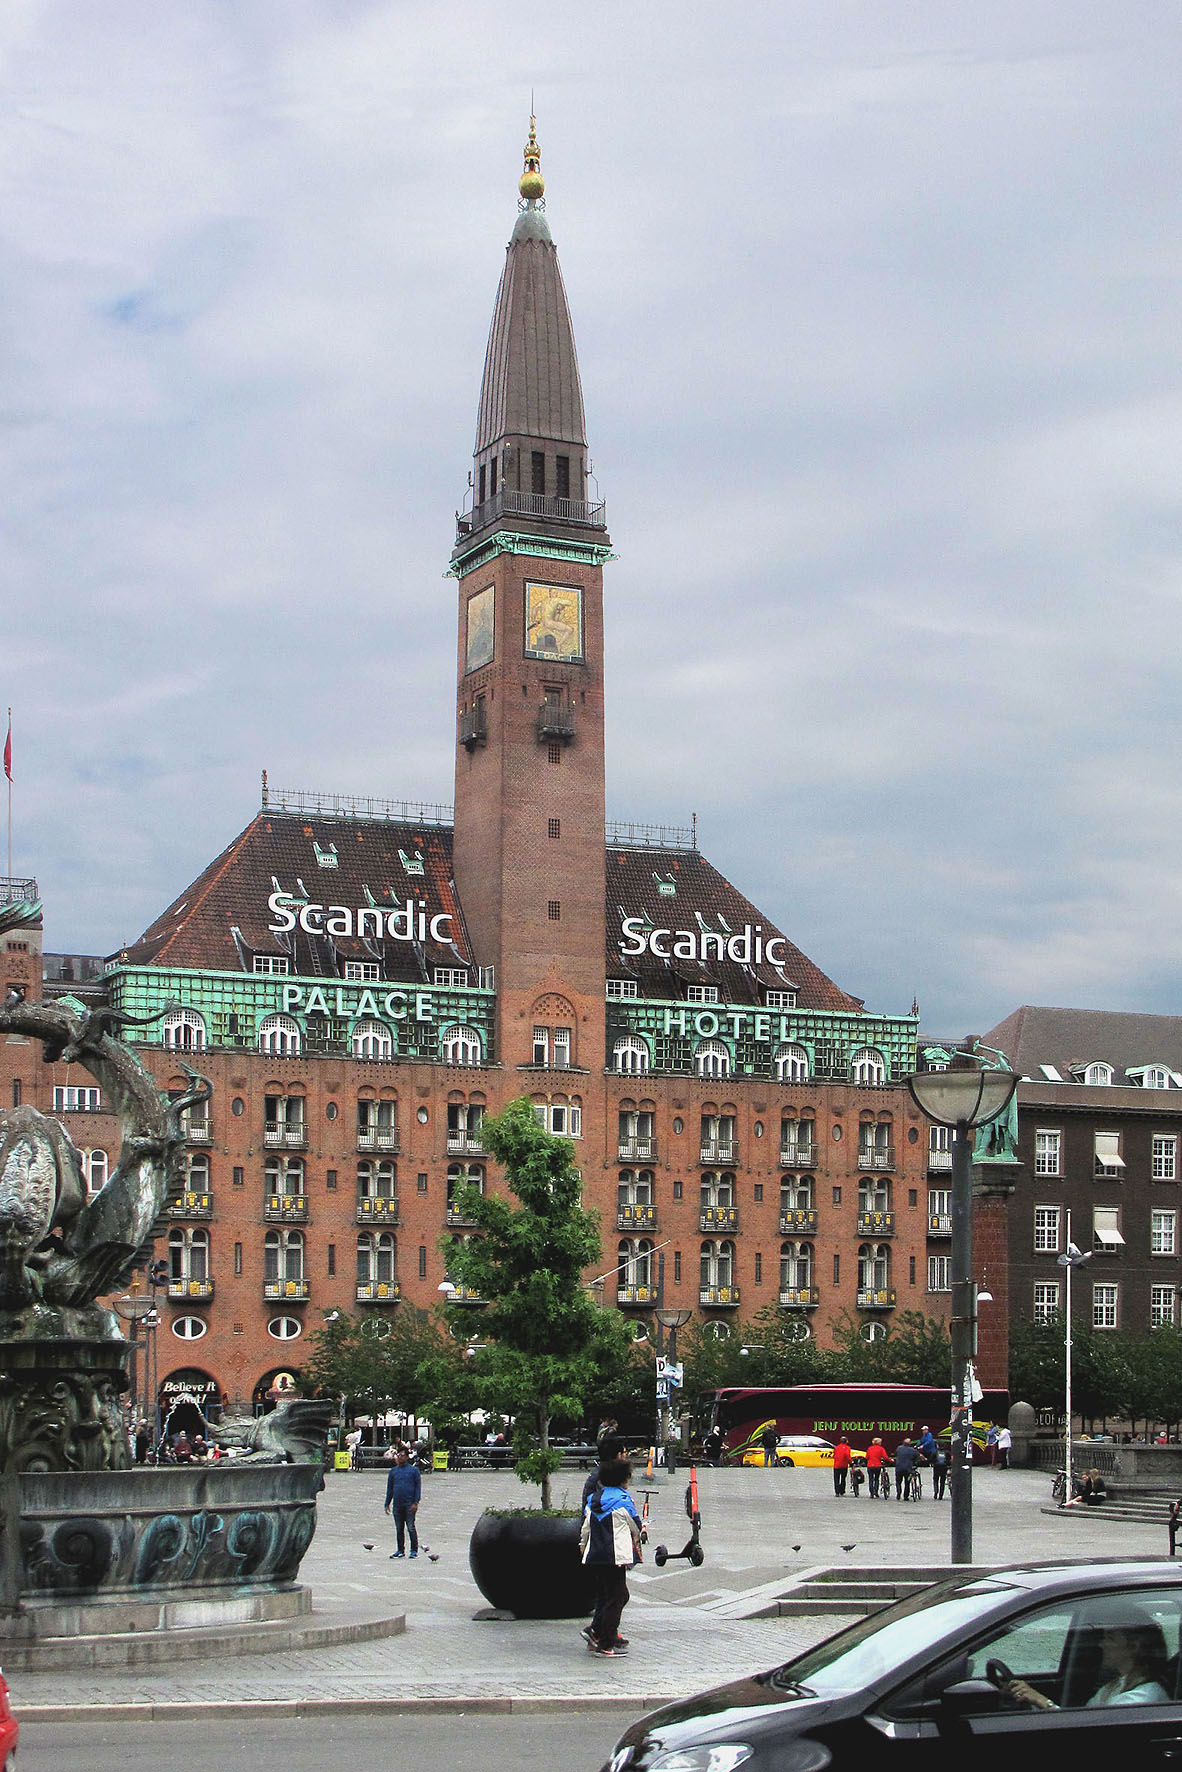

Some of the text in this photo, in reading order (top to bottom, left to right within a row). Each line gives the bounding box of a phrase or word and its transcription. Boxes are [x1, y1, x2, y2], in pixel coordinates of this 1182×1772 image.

[268, 892, 453, 944] Scandic
[621, 917, 786, 966] Scandic
[282, 984, 433, 1022] PALACE
[663, 1008, 797, 1043] HOTEL
[163, 1381, 216, 1392] Believe It
[812, 1421, 838, 1432] JENS
[877, 1421, 915, 1431] TURIST
